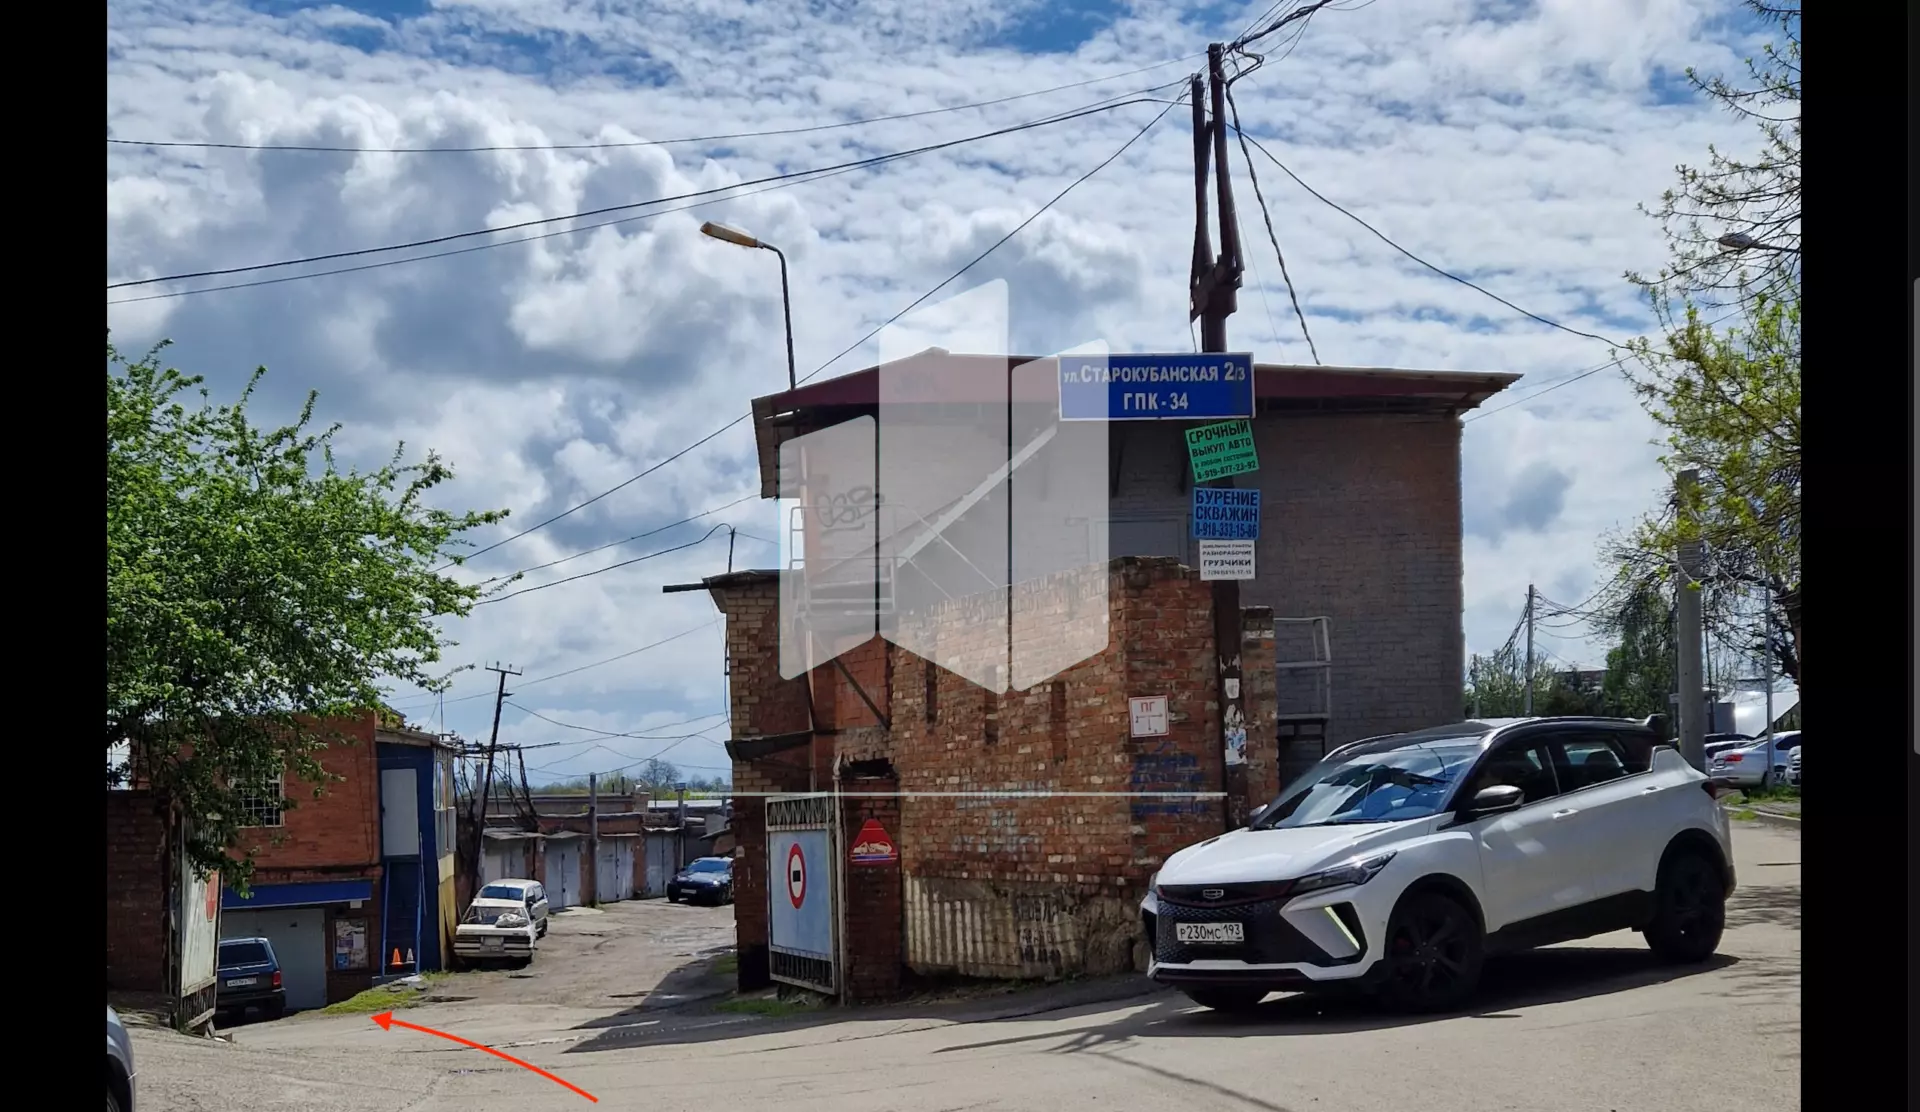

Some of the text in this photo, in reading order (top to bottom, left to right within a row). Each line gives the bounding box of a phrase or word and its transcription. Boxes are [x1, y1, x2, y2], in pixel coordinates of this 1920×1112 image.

[1224, 361, 1246, 381] 2/3
[1188, 421, 1249, 444] СРОЧНЫЙ
[1192, 437, 1252, 457] ВЫКУП АВТО
[1195, 490, 1258, 506] БУРЕНИЕ
[1195, 506, 1258, 522] СКВАЖИН
[1203, 559, 1251, 567] ГРУЗЧИКИ
[1223, 923, 1241, 936] 193
